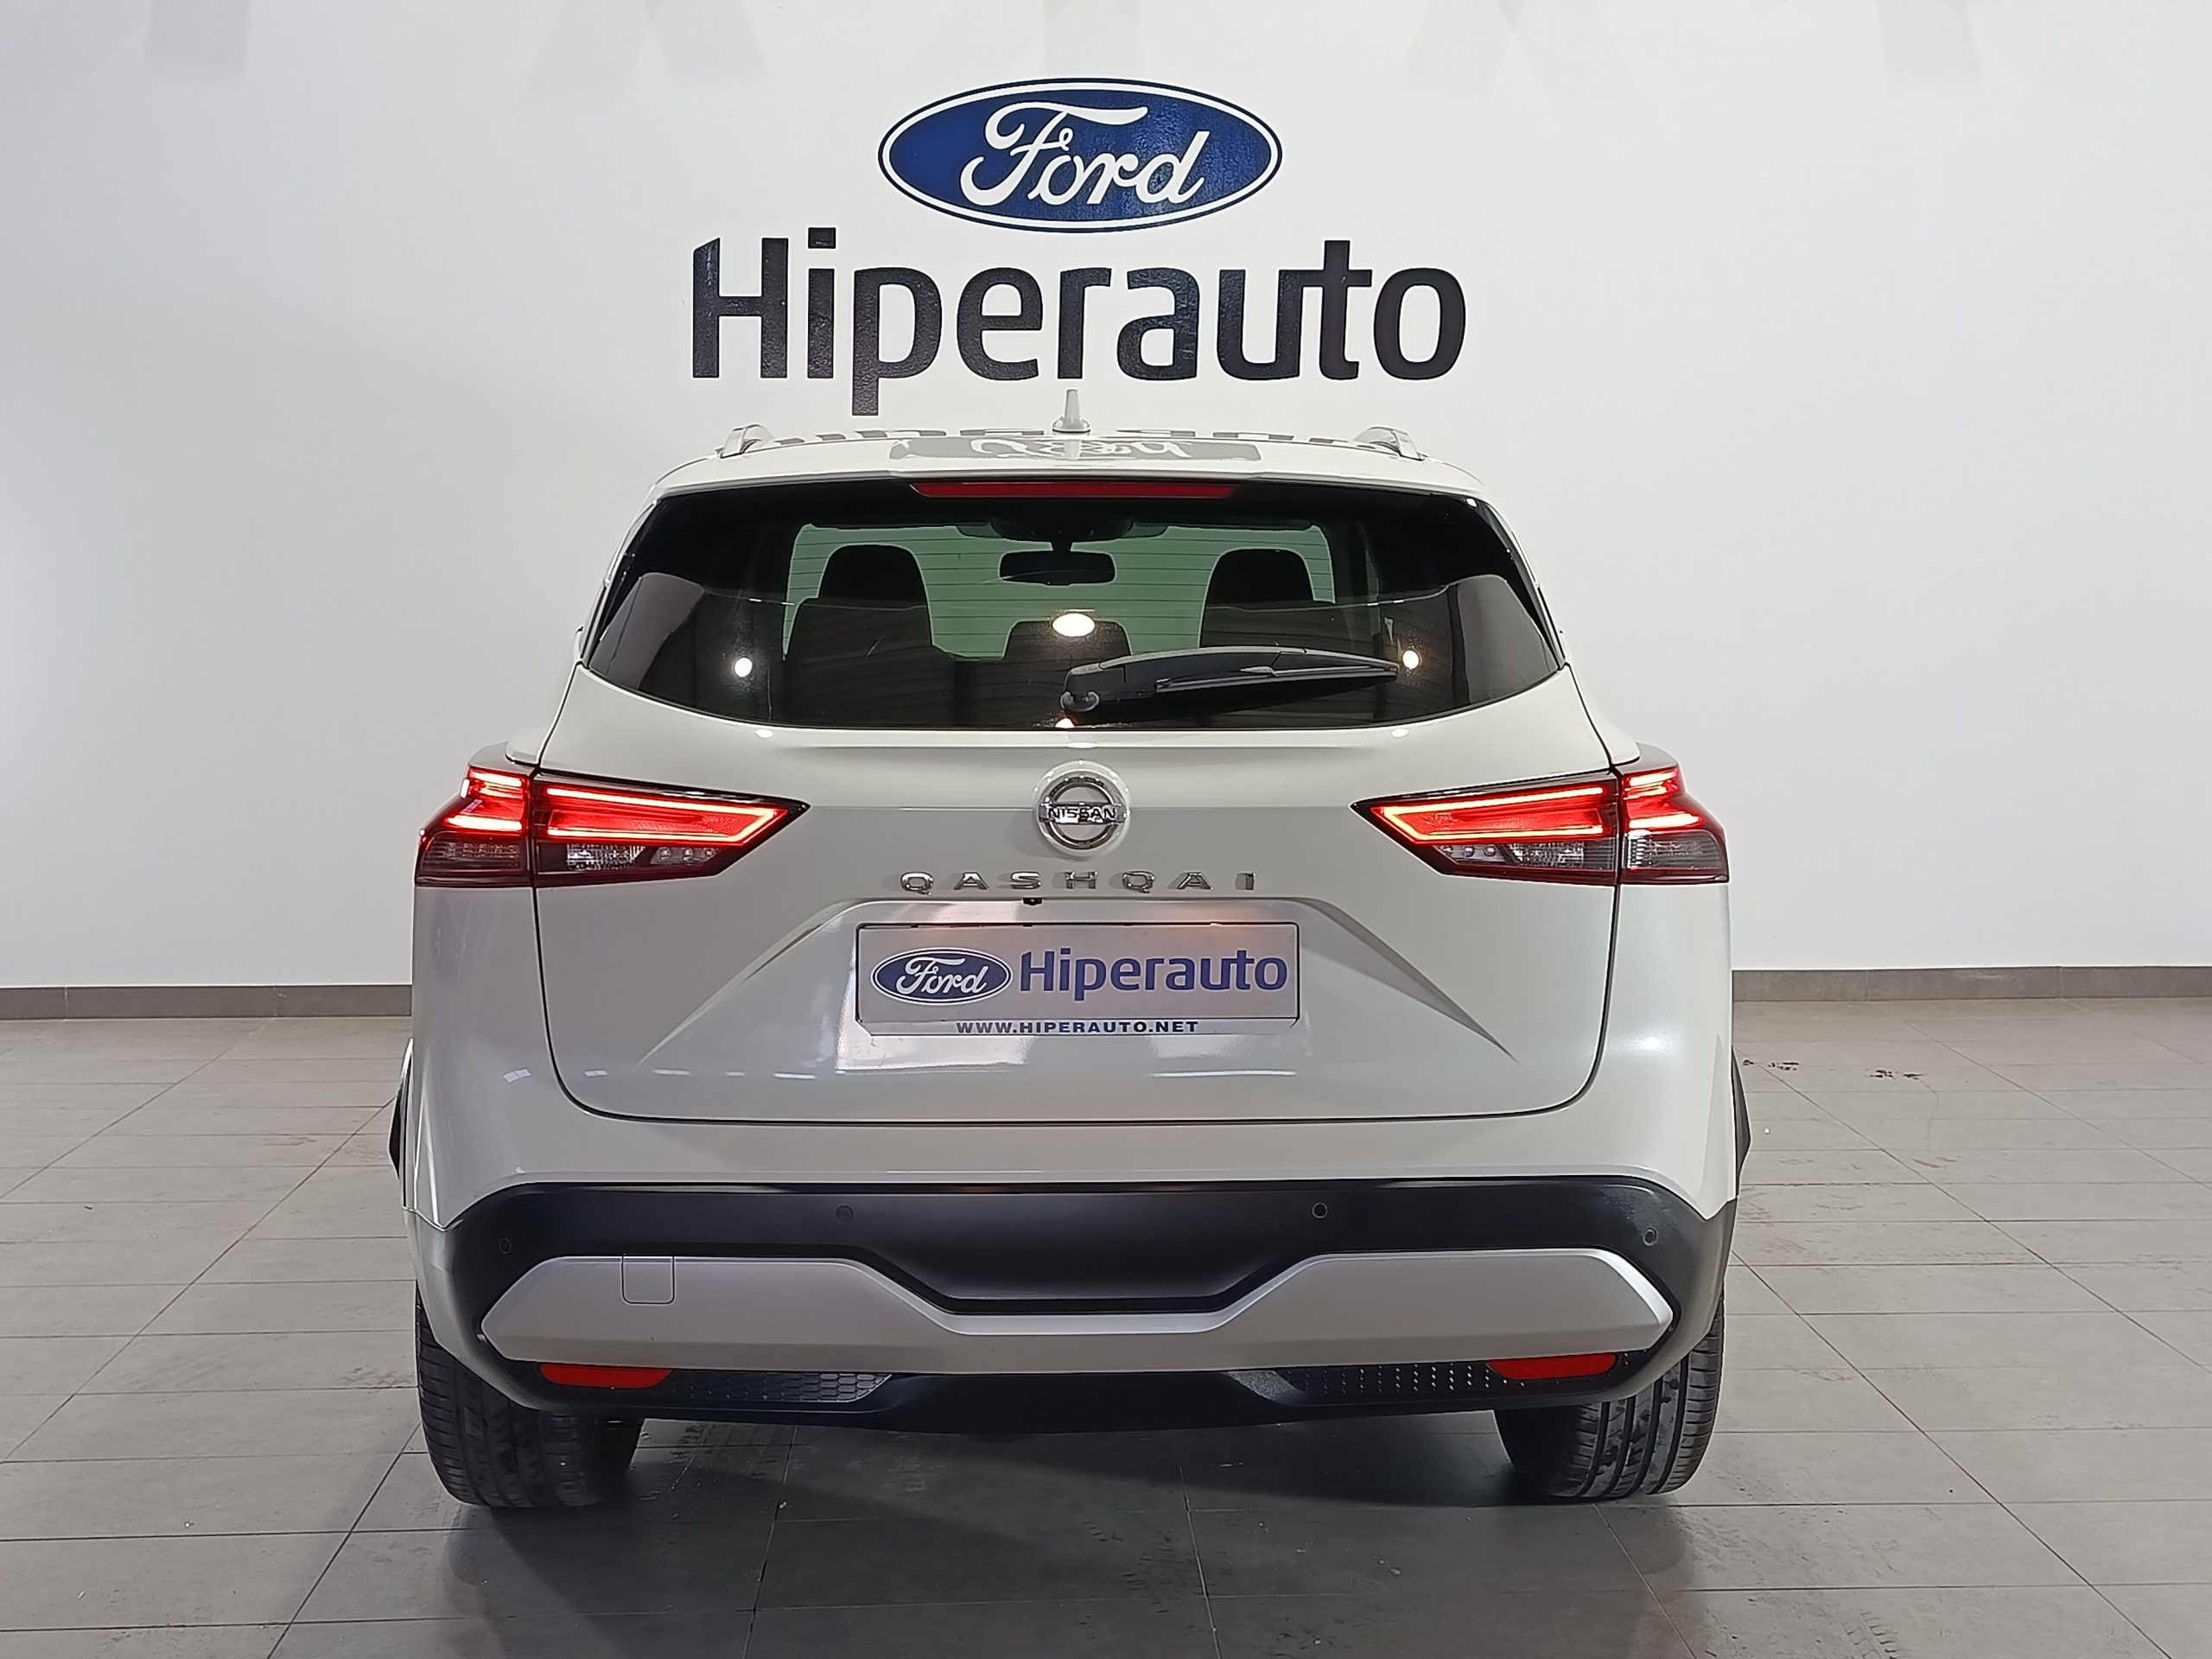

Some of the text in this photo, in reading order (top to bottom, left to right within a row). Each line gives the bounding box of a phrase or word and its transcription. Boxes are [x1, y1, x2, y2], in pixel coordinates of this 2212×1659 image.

[960, 101, 1211, 207] Ford
[692, 227, 1466, 416] Hiperauto
[1047, 807, 1117, 821] NISSAN
[900, 871, 1255, 894] QASHQAI
[897, 948, 1287, 1001] Ford Hiperauto
[956, 1020, 1199, 1034] WWW.HIPERAUTO.NET
